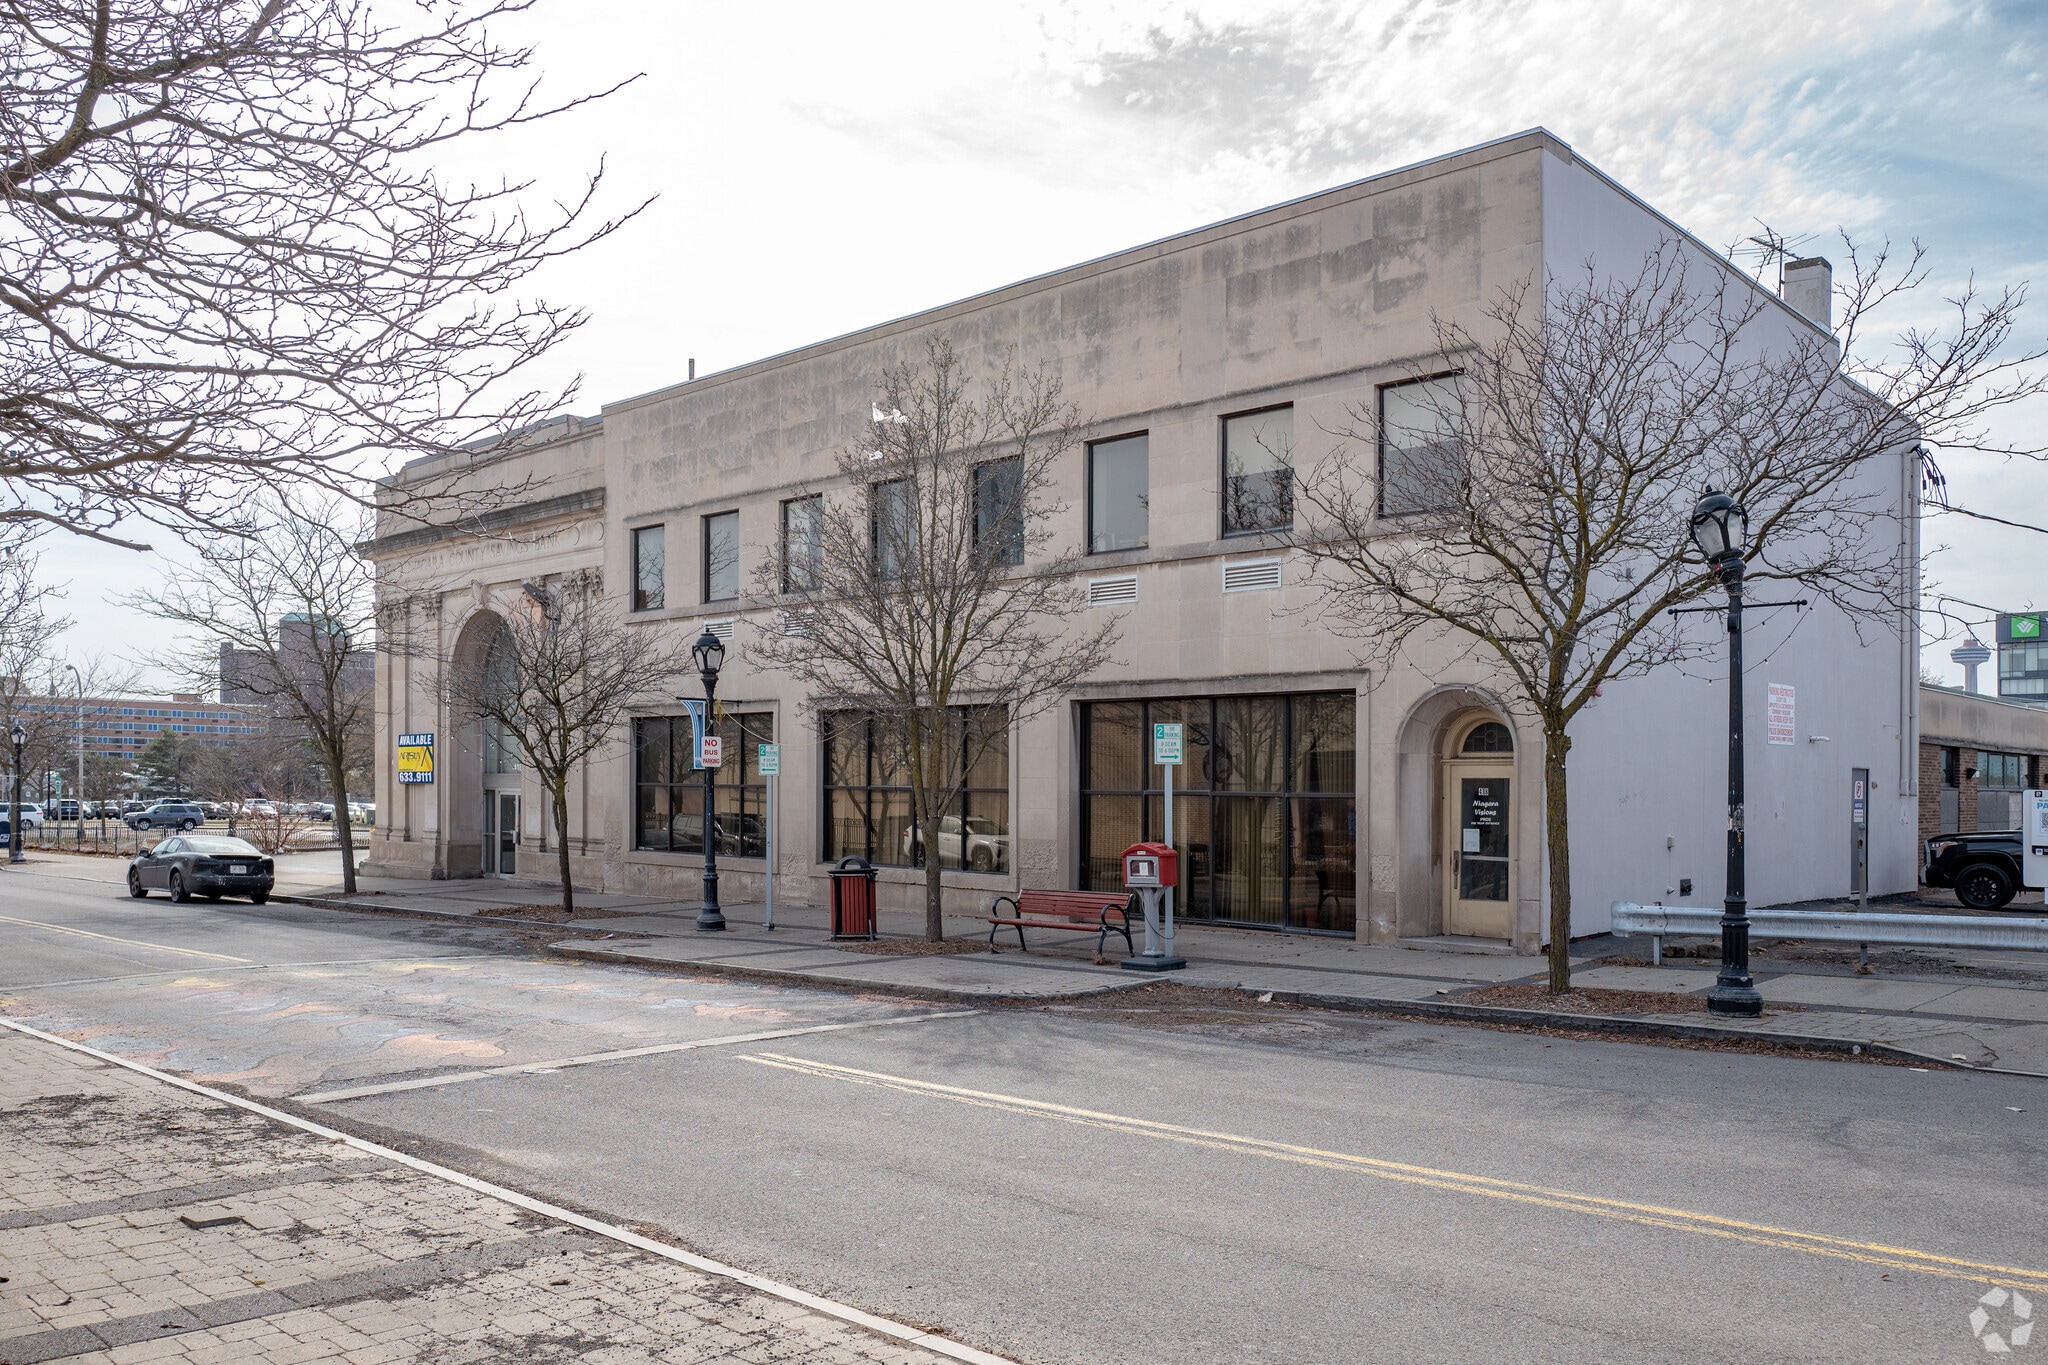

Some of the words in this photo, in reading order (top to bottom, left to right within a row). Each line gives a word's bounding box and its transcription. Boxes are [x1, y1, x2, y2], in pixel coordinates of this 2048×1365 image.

[449, 546, 487, 563] COUNTY
[490, 540, 529, 558] SAVINGS
[1157, 726, 1164, 737] 2
[399, 735, 432, 745] AVAILABLE
[399, 772, 432, 782] 633.9111
[1472, 800, 1499, 808] Niagara
